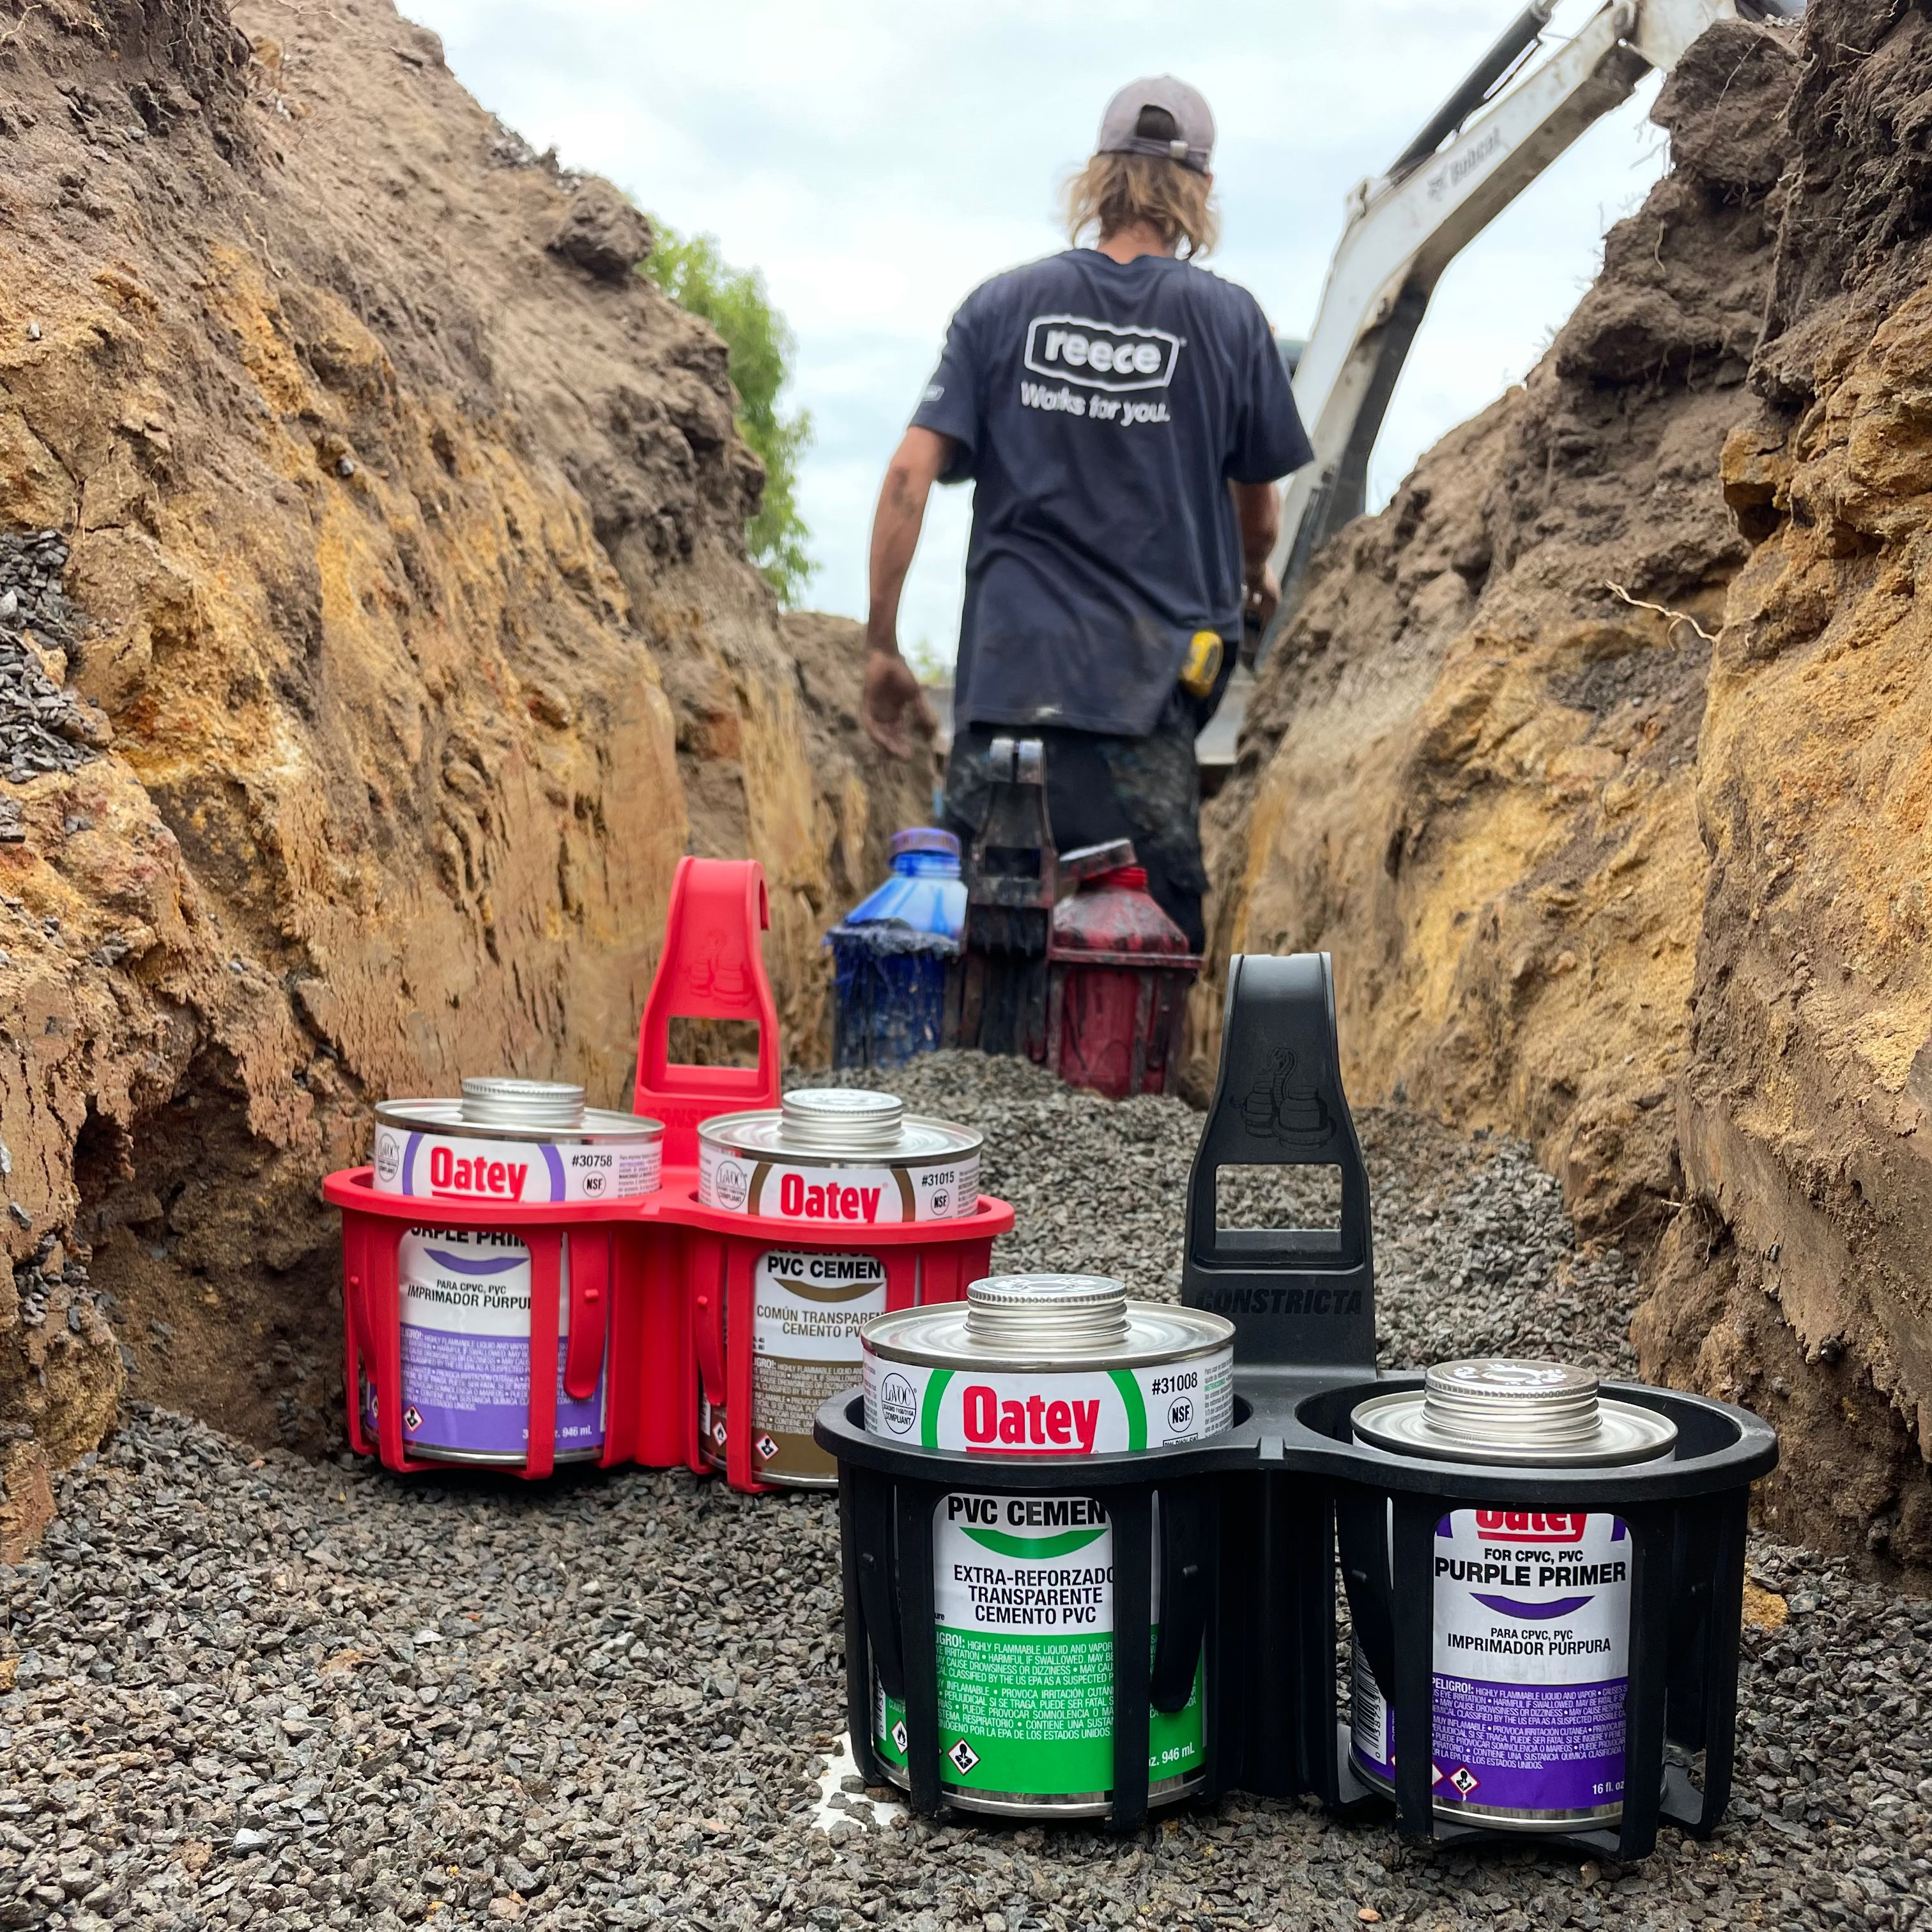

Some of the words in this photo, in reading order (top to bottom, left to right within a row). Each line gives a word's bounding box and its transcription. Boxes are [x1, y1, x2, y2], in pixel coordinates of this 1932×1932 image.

[1044, 330, 1162, 374] reece
[1021, 380, 1086, 416] Works
[1089, 394, 1121, 420] for
[1121, 401, 1170, 427] you.
[572, 1154, 613, 1167] #30758
[431, 1146, 528, 1202] Oatey
[922, 1171, 954, 1187] #31015
[586, 1178, 603, 1190] NSF
[781, 1173, 882, 1223] Oatey
[934, 1195, 947, 1208] NSF
[768, 1255, 804, 1276] PVC
[810, 1260, 887, 1278] CEMEN
[408, 1284, 479, 1307] IMPRIMADOR
[437, 1279, 457, 1291] PARA
[460, 1282, 486, 1293] CPVC,
[488, 1284, 507, 1296] PVC
[1195, 1288, 1363, 1315] CONSTRICTA
[757, 1305, 798, 1322] COMÚN
[783, 1322, 841, 1338] CEMENTO
[1152, 1372, 1198, 1395] #31008
[885, 1382, 912, 1406] LoVOC
[885, 1411, 912, 1425] COMPLIANT
[963, 1385, 1100, 1455] Oatey
[1172, 1405, 1190, 1423] NSF
[562, 1427, 579, 1438] 946
[947, 1496, 998, 1525] PVC
[1484, 1548, 1512, 1561] FOR
[1515, 1550, 1554, 1565] CPVC,
[1558, 1550, 1584, 1563] PVC
[1434, 1556, 1531, 1587] PURPLE
[1538, 1561, 1627, 1587] PRIMER
[968, 1585, 1103, 1606] TRANSPARENTE
[975, 1605, 1057, 1625] CEMENTO
[1062, 1606, 1096, 1624] PVC
[935, 1631, 965, 1649] IGRO!:
[968, 1640, 992, 1653] HIGHLY
[994, 1643, 1041, 1655] FLAMMABLE
[1043, 1645, 1068, 1655] LIQUID
[1070, 1644, 1087, 1654] AND
[1089, 1642, 1113, 1653] VAPOR
[1491, 1627, 1518, 1639] PARA
[1521, 1629, 1551, 1641] CPVC,
[1554, 1630, 1574, 1641] PVC
[1448, 1633, 1544, 1655] IMPRIMADOR
[945, 1646, 980, 1661] IRRITATION
[988, 1653, 1025, 1665] HARMFUL
[1026, 1655, 1033, 1664] IF
[1035, 1655, 1086, 1665] SWALLOWED.
[1087, 1653, 1104, 1663] MAY
[946, 1657, 968, 1669] CAUSE
[969, 1660, 1017, 1675] DROWSINESS
[1019, 1666, 1030, 1675] OR
[1032, 1665, 1071, 1675] DIZZINESS
[1080, 1664, 1096, 1674] MAY
[1098, 1662, 1114, 1673] CAU
[948, 1667, 986, 1682] CLASSIFIED
[988, 1674, 998, 1683] BY
[999, 1674, 1014, 1685] THE
[1016, 1675, 1026, 1685] US
[1028, 1676, 1043, 1685] EPA
[1043, 1676, 1054, 1685] AS
[1055, 1676, 1061, 1685] A
[1062, 1673, 1107, 1685] SUSPECTED
[946, 1680, 990, 1696] INFLAMABLE
[1001, 1688, 1038, 1699] PROVOCA
[1041, 1687, 1084, 1699] IRRITACIÓN
[1087, 1684, 1114, 1698] CUTÁN
[1475, 1687, 1498, 1697] HIGHLY
[1499, 1690, 1540, 1700] FLAMMABLE
[1541, 1692, 1562, 1701] LIQUID
[1563, 1692, 1576, 1700] AND
[1577, 1689, 1597, 1699] VAPOR
[945, 1690, 988, 1706] PERJUDICIAL
[989, 1697, 997, 1707] SI
[998, 1698, 1009, 1708] SE
[1039, 1699, 1066, 1710] PUEDE
[1068, 1699, 1083, 1709] SER
[1085, 1697, 1107, 1707] FATAL
[1439, 1698, 1453, 1708] MAY
[1454, 1701, 1475, 1712] CAUSE
[1476, 1703, 1519, 1717] DROWSINESS
[1520, 1708, 1529, 1717] OR
[1530, 1708, 1563, 1717] DIZZINESS
[1441, 1690, 1453, 1700] EYE
[1453, 1692, 1487, 1705] IRRITATION
[1493, 1698, 1525, 1708] HARMFUL
[1526, 1700, 1532, 1708] IF
[1575, 1699, 1589, 1708] MAY
[962, 1704, 986, 1716] PUEDE
[988, 1707, 1029, 1719] PROVOCAR
[1032, 1709, 1090, 1719] SOMNOLENCIA
[1092, 1708, 1099, 1717] O
[1457, 1709, 1493, 1722] CLASSIFIED
[1494, 1714, 1503, 1723] BY
[1504, 1714, 1517, 1724] THE
[1517, 1716, 1527, 1725] US
[1528, 1717, 1541, 1725] EPA
[1541, 1717, 1551, 1725] AS
[1557, 1715, 1592, 1724] SUSPECTED
[962, 1713, 1014, 1729] RESPIRATORIO
[1025, 1720, 1064, 1730] CONTIENE
[1068, 1719, 1084, 1729] UNA
[970, 1725, 985, 1736] POR
[986, 1727, 997, 1737] LA
[997, 1728, 1013, 1738] EPA
[1013, 1729, 1025, 1740] DE
[1026, 1730, 1042, 1740] LOS
[1043, 1729, 1080, 1740] ESTADOS
[1162, 1747, 1180, 1764] 946
[1182, 1742, 1195, 1757] mL
[1592, 1783, 1604, 1795] 16
[1606, 1782, 1614, 1793] fl.
